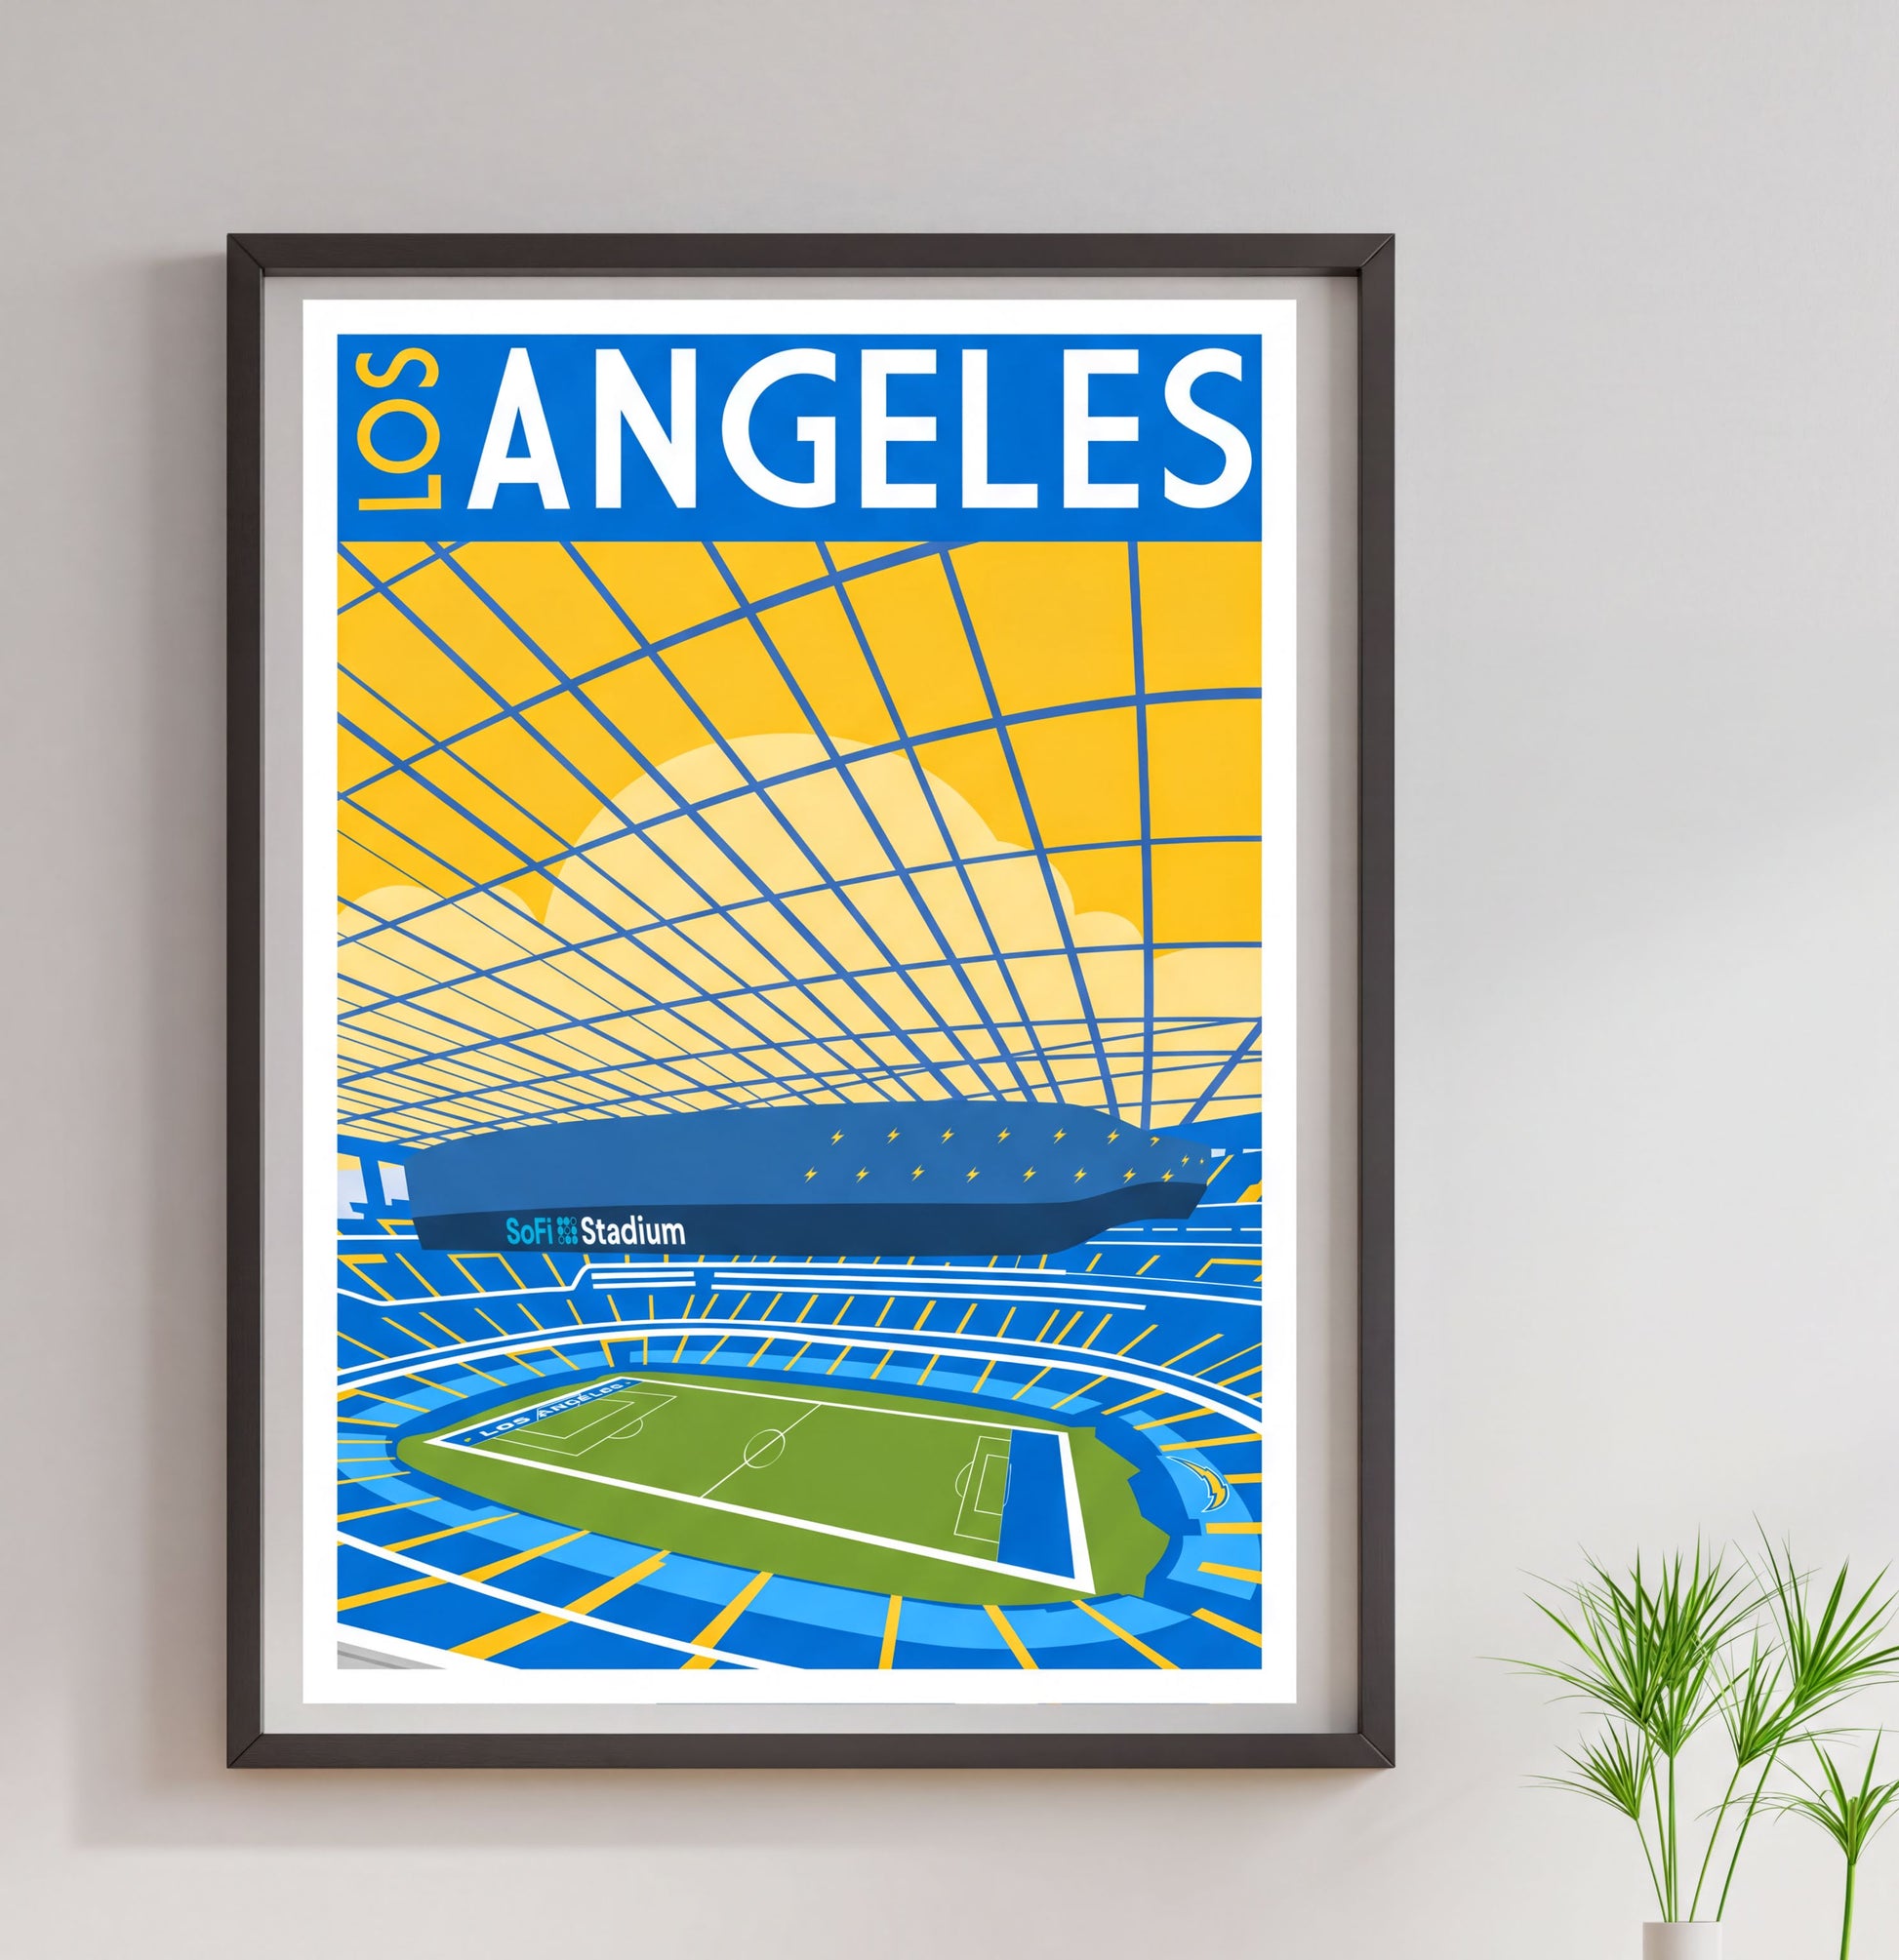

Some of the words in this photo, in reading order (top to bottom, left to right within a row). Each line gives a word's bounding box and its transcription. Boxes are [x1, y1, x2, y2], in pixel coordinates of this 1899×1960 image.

[356, 348, 441, 510] LOS
[467, 348, 1252, 509] ANGELES
[506, 1218, 553, 1245] SoFi
[582, 1216, 686, 1245] Stadium
[479, 1416, 531, 1437] LOS
